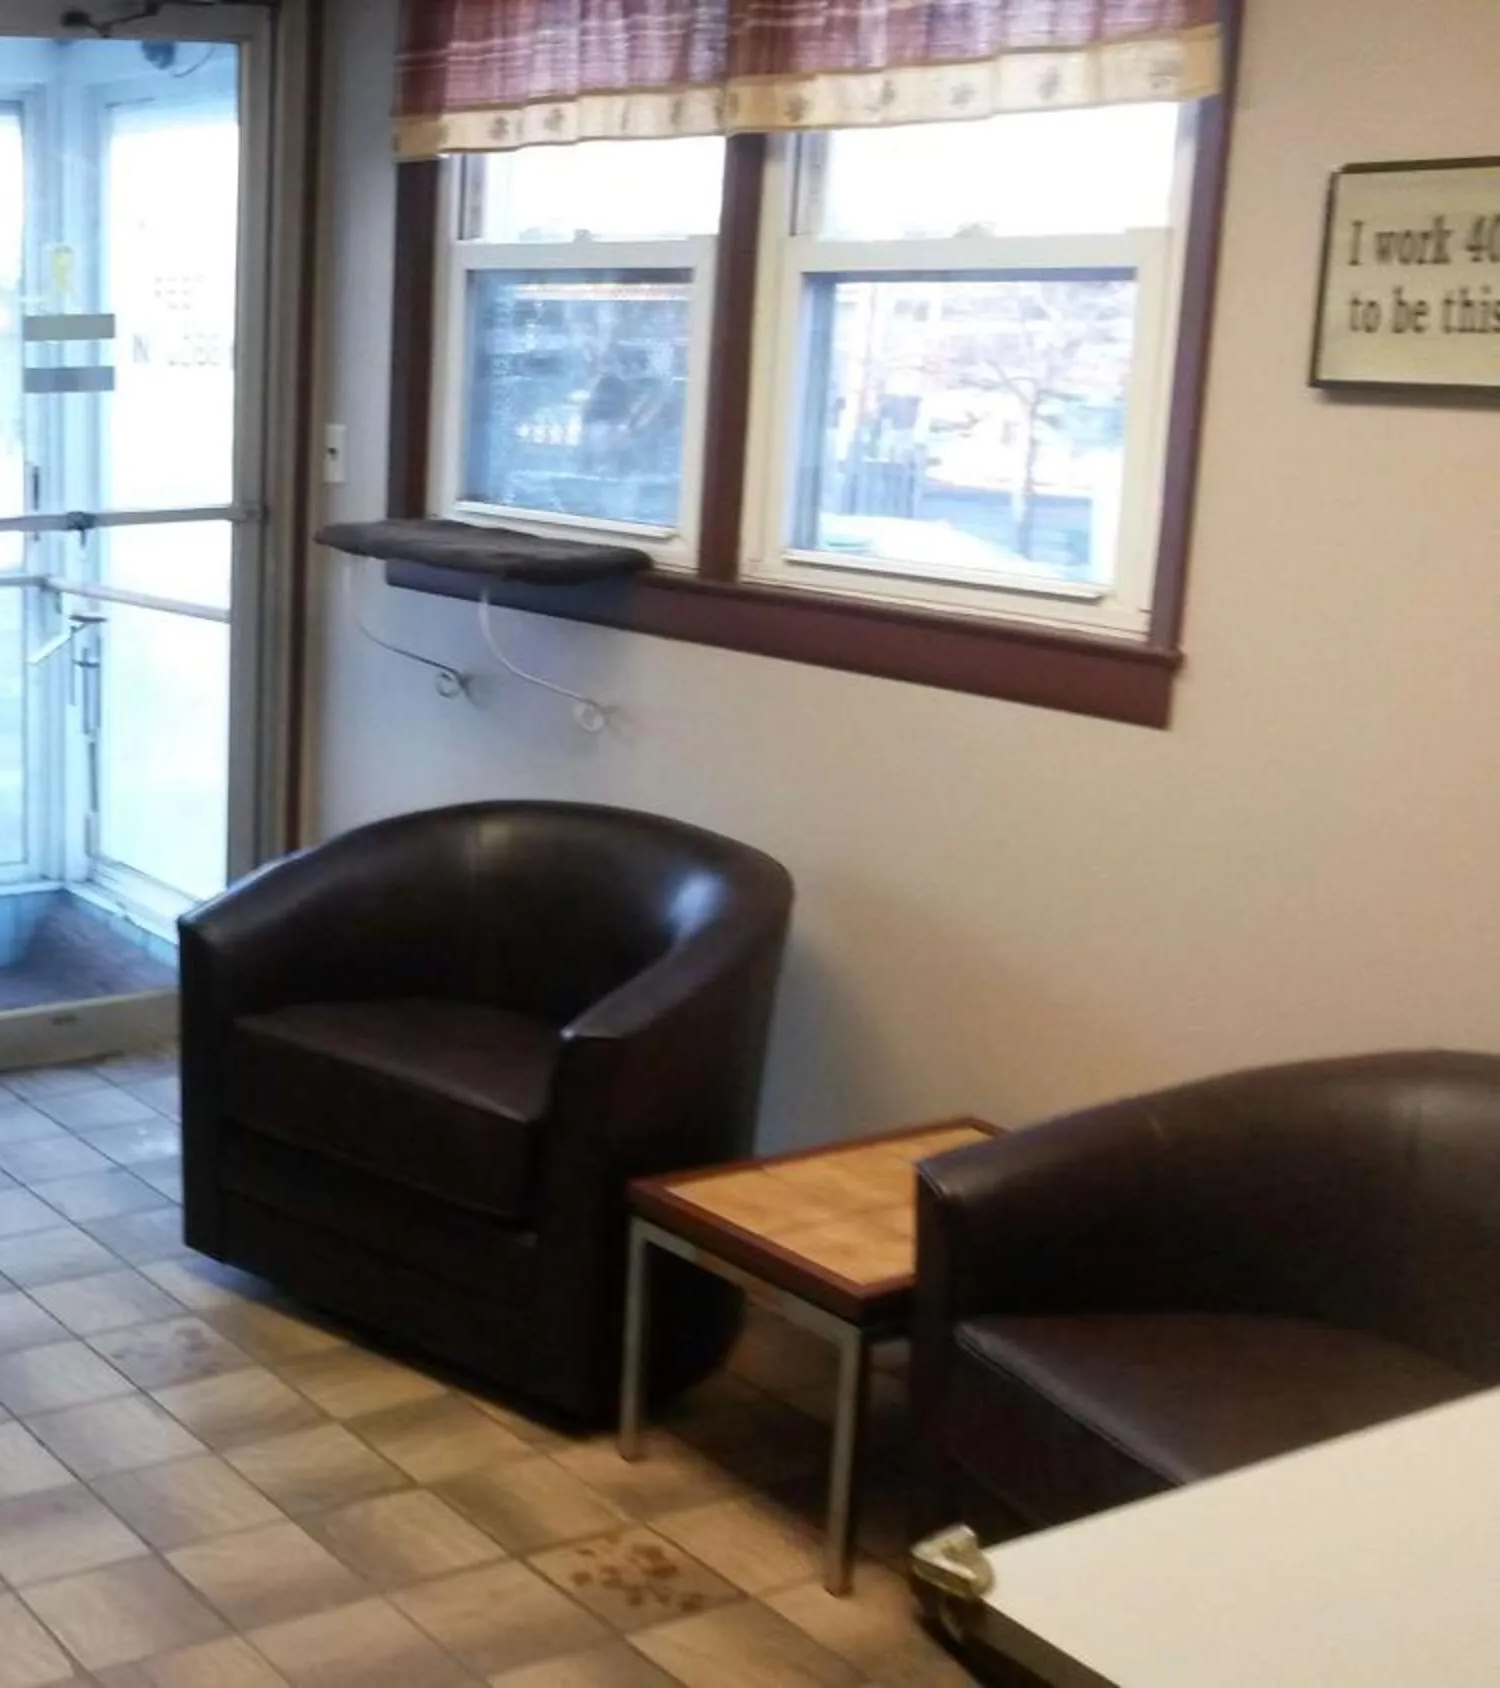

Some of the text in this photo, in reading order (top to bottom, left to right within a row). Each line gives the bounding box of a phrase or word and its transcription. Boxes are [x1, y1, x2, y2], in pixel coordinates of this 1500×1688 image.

[1347, 219, 1365, 266] I
[1374, 214, 1453, 266] work
[1348, 293, 1381, 333] to
[1391, 285, 1430, 334] be
